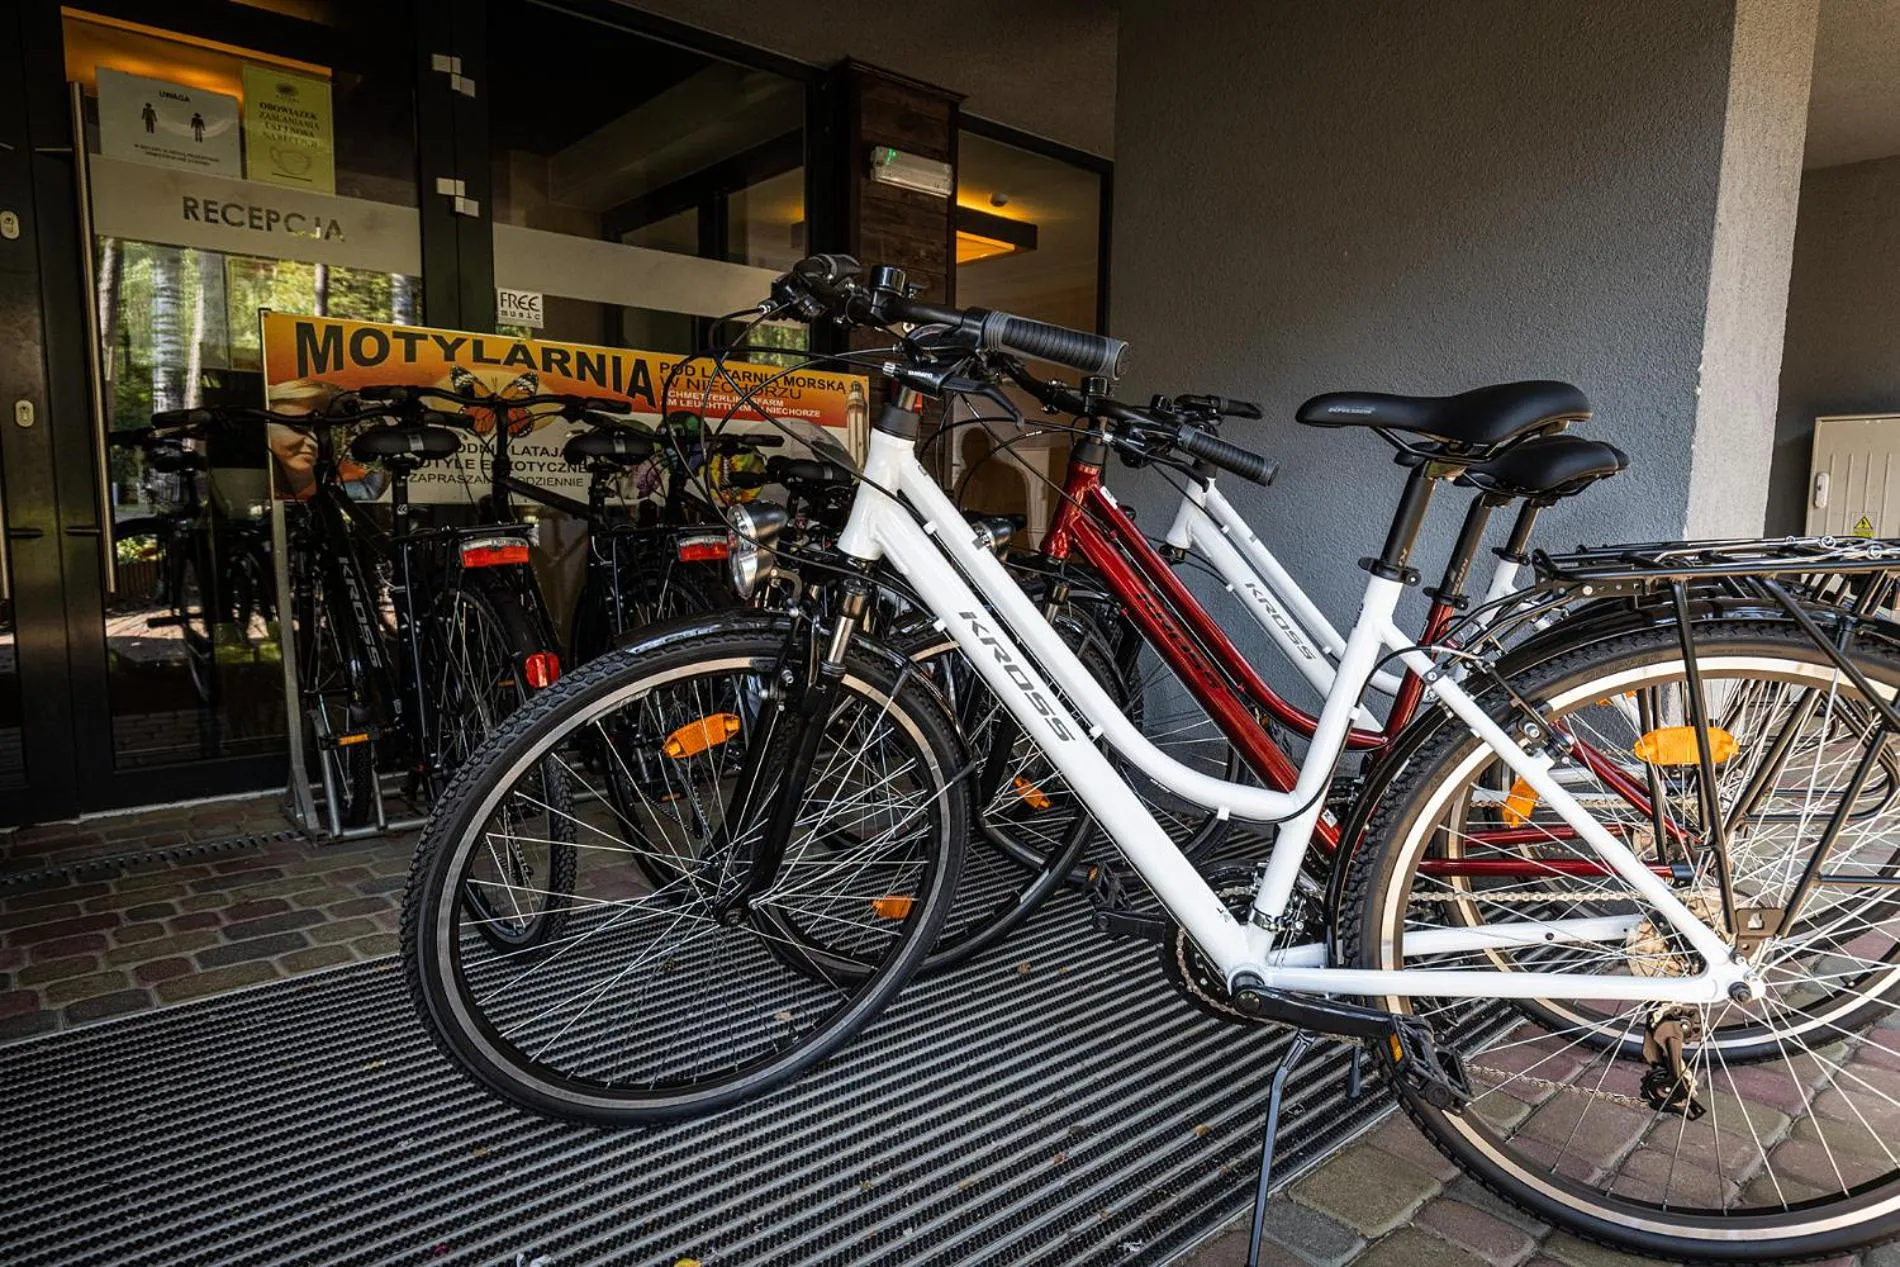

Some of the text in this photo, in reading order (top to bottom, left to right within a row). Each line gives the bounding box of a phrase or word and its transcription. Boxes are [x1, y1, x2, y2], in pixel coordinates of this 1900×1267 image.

[182, 196, 345, 242] RECEPCJA
[500, 292, 540, 312] FREE
[295, 322, 655, 409] MOTYLARNIA
[660, 362, 696, 377] POD
[660, 390, 784, 407] CHMETTERLINSFARM
[337, 556, 383, 669] KROSS
[1244, 582, 1317, 660] KROSS
[958, 611, 1077, 741] KROSS
